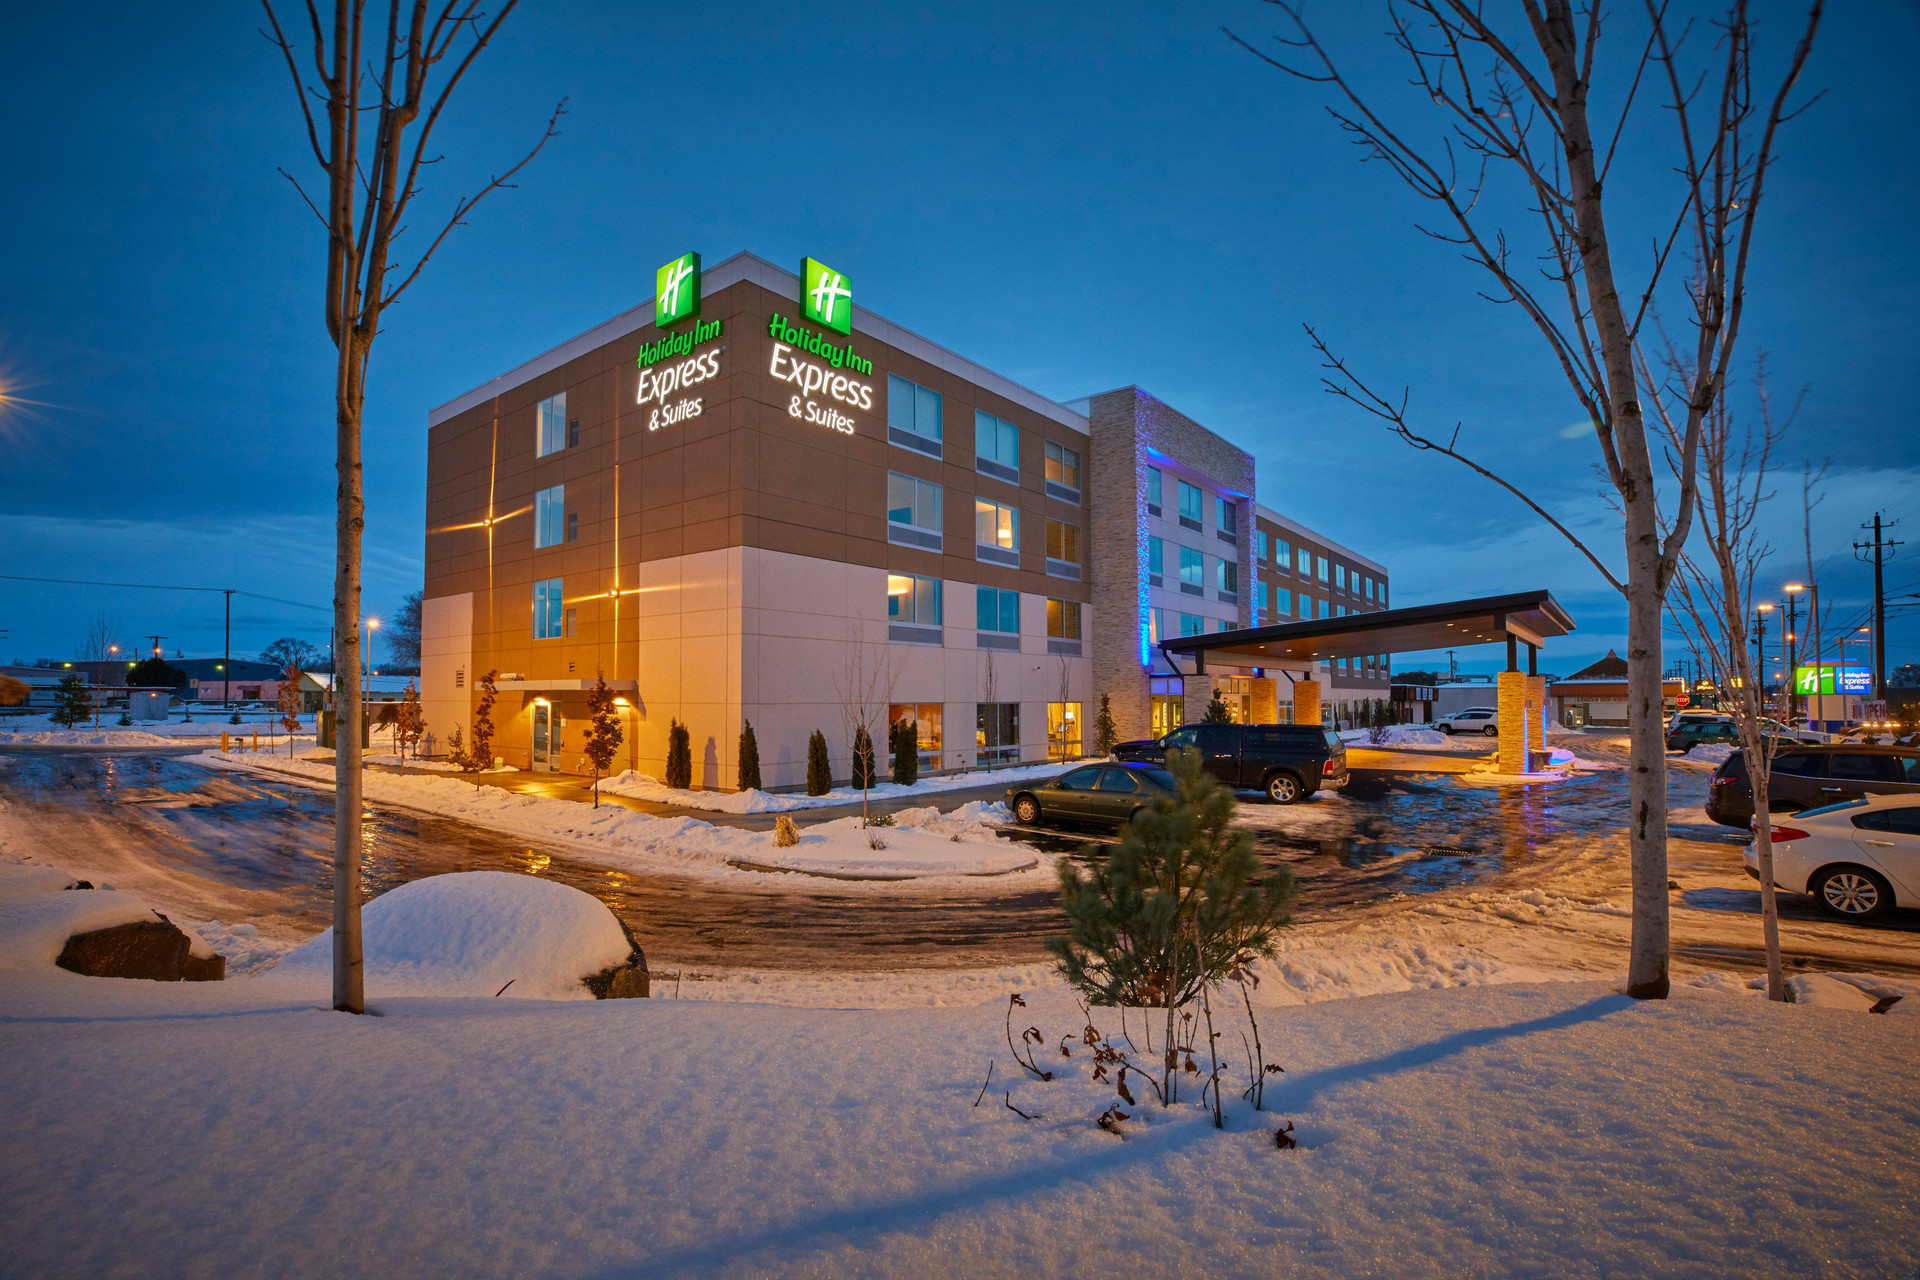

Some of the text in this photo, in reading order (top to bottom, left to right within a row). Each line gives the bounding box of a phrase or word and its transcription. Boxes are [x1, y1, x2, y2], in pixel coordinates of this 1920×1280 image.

[637, 319, 720, 368] Holiday Inn
[769, 313, 872, 376] Holiday Inn
[636, 349, 720, 404] Express
[769, 343, 872, 409] Express
[649, 398, 702, 431] & Suites
[788, 396, 854, 434] & Suites
[1864, 703, 1886, 718] OPEN
